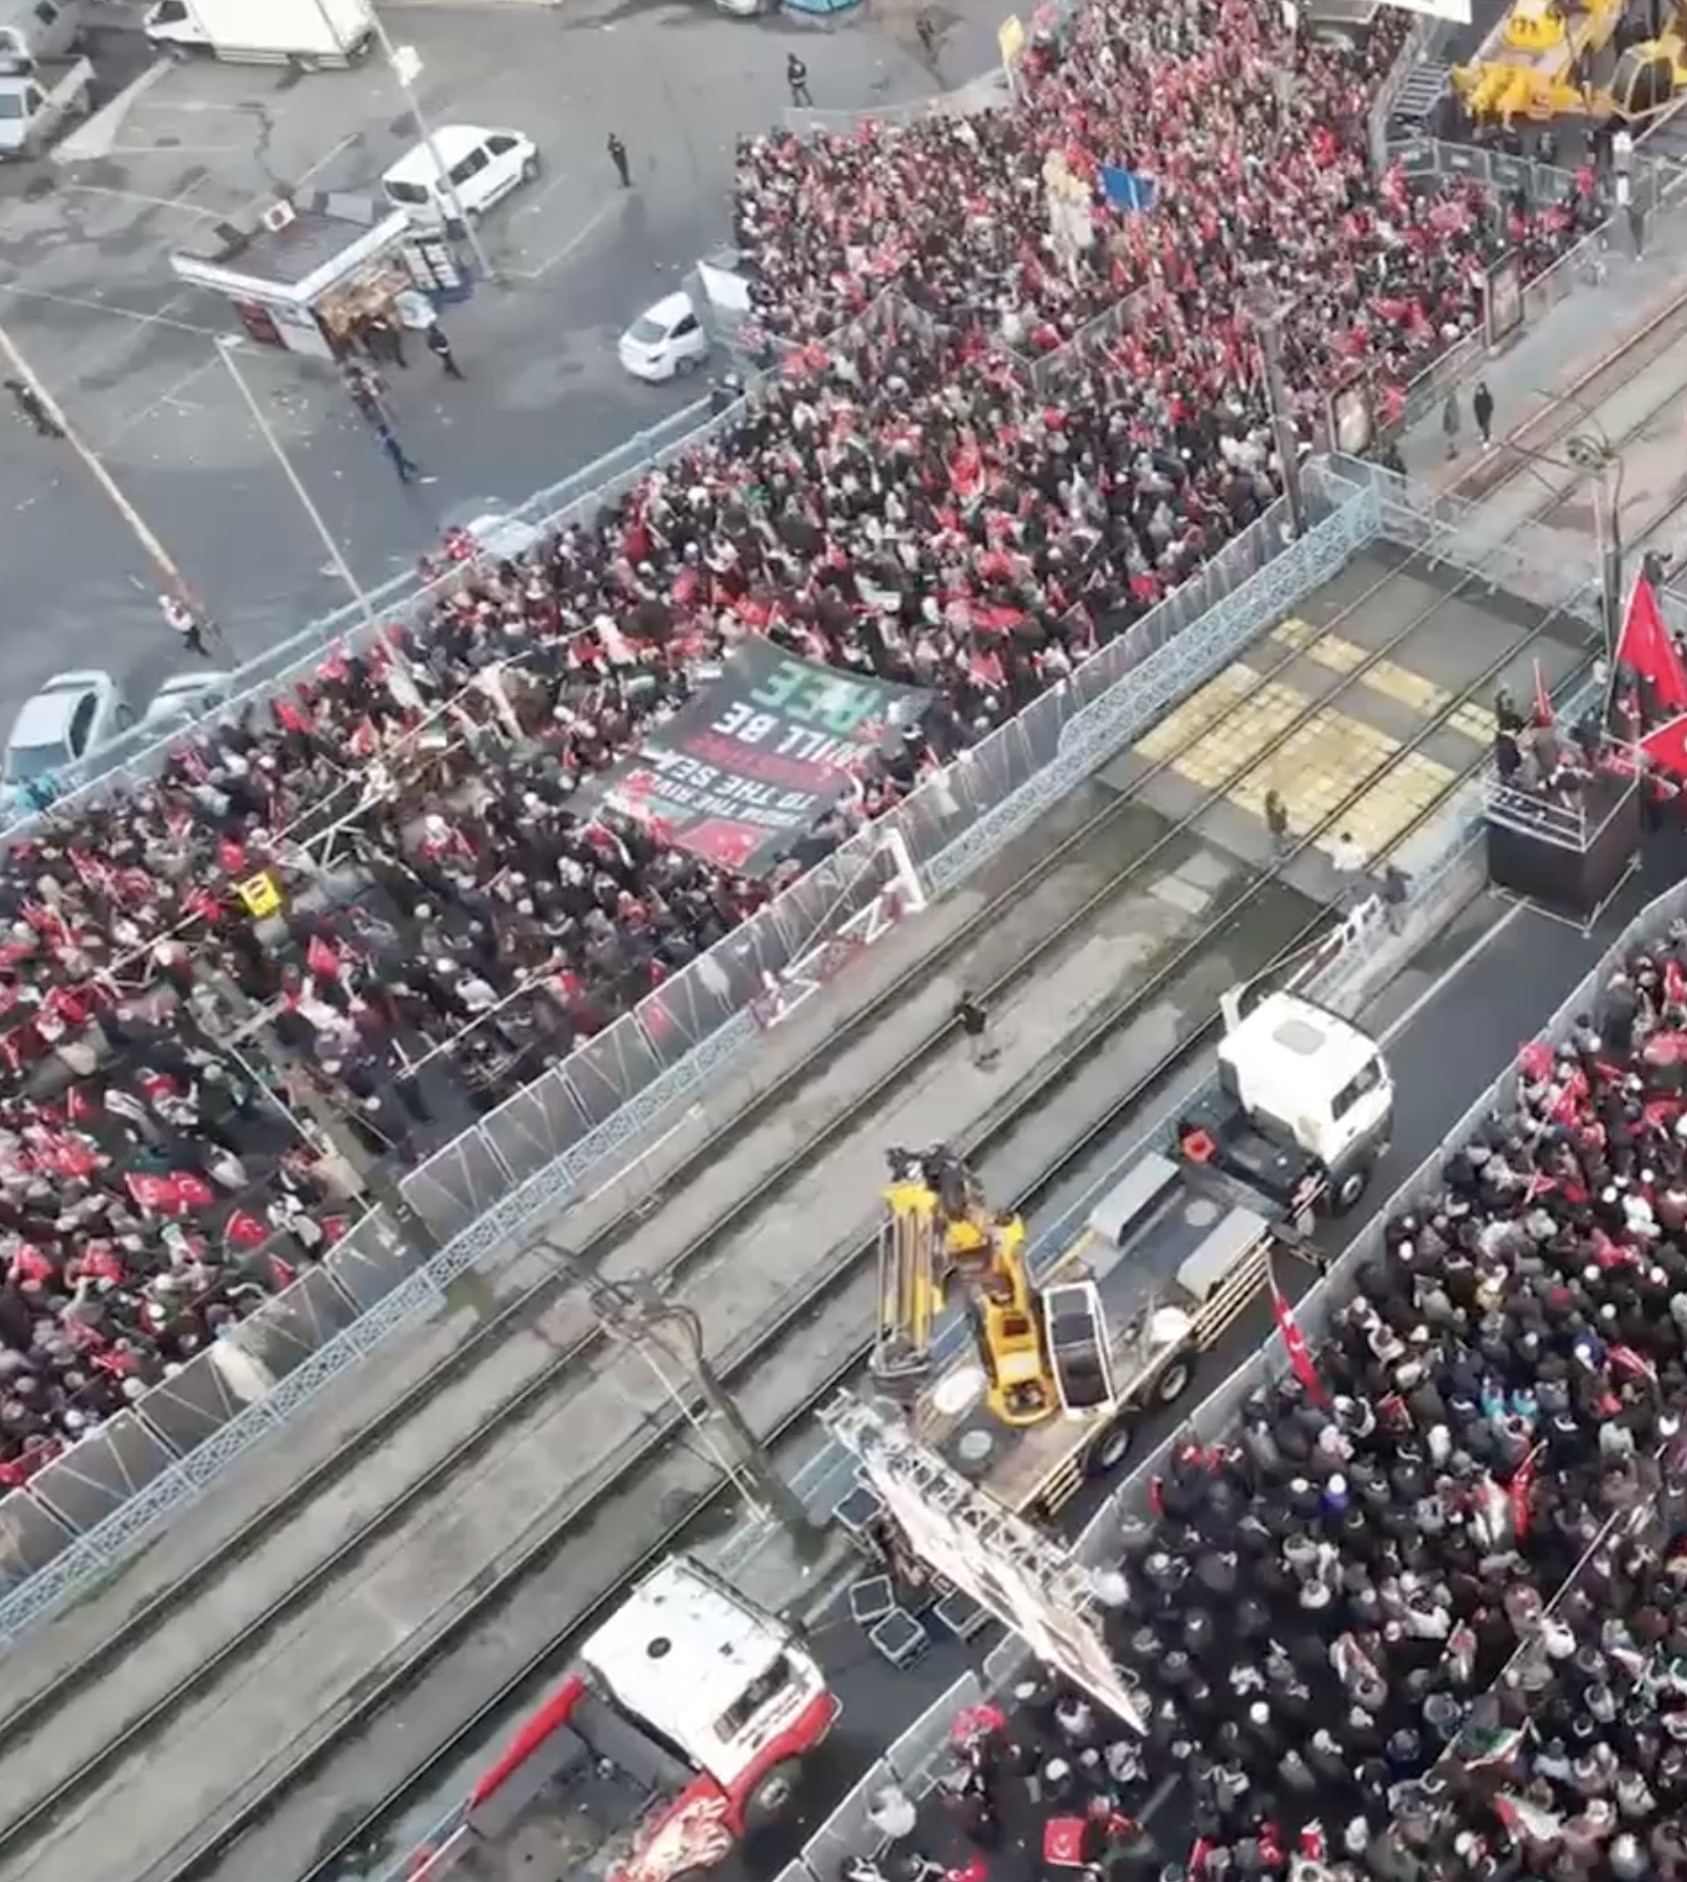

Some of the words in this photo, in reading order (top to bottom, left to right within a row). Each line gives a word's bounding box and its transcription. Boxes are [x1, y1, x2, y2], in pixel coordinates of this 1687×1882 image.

[711, 702, 779, 743] BE
[714, 774, 776, 805] THE
[776, 793, 819, 810] TO
